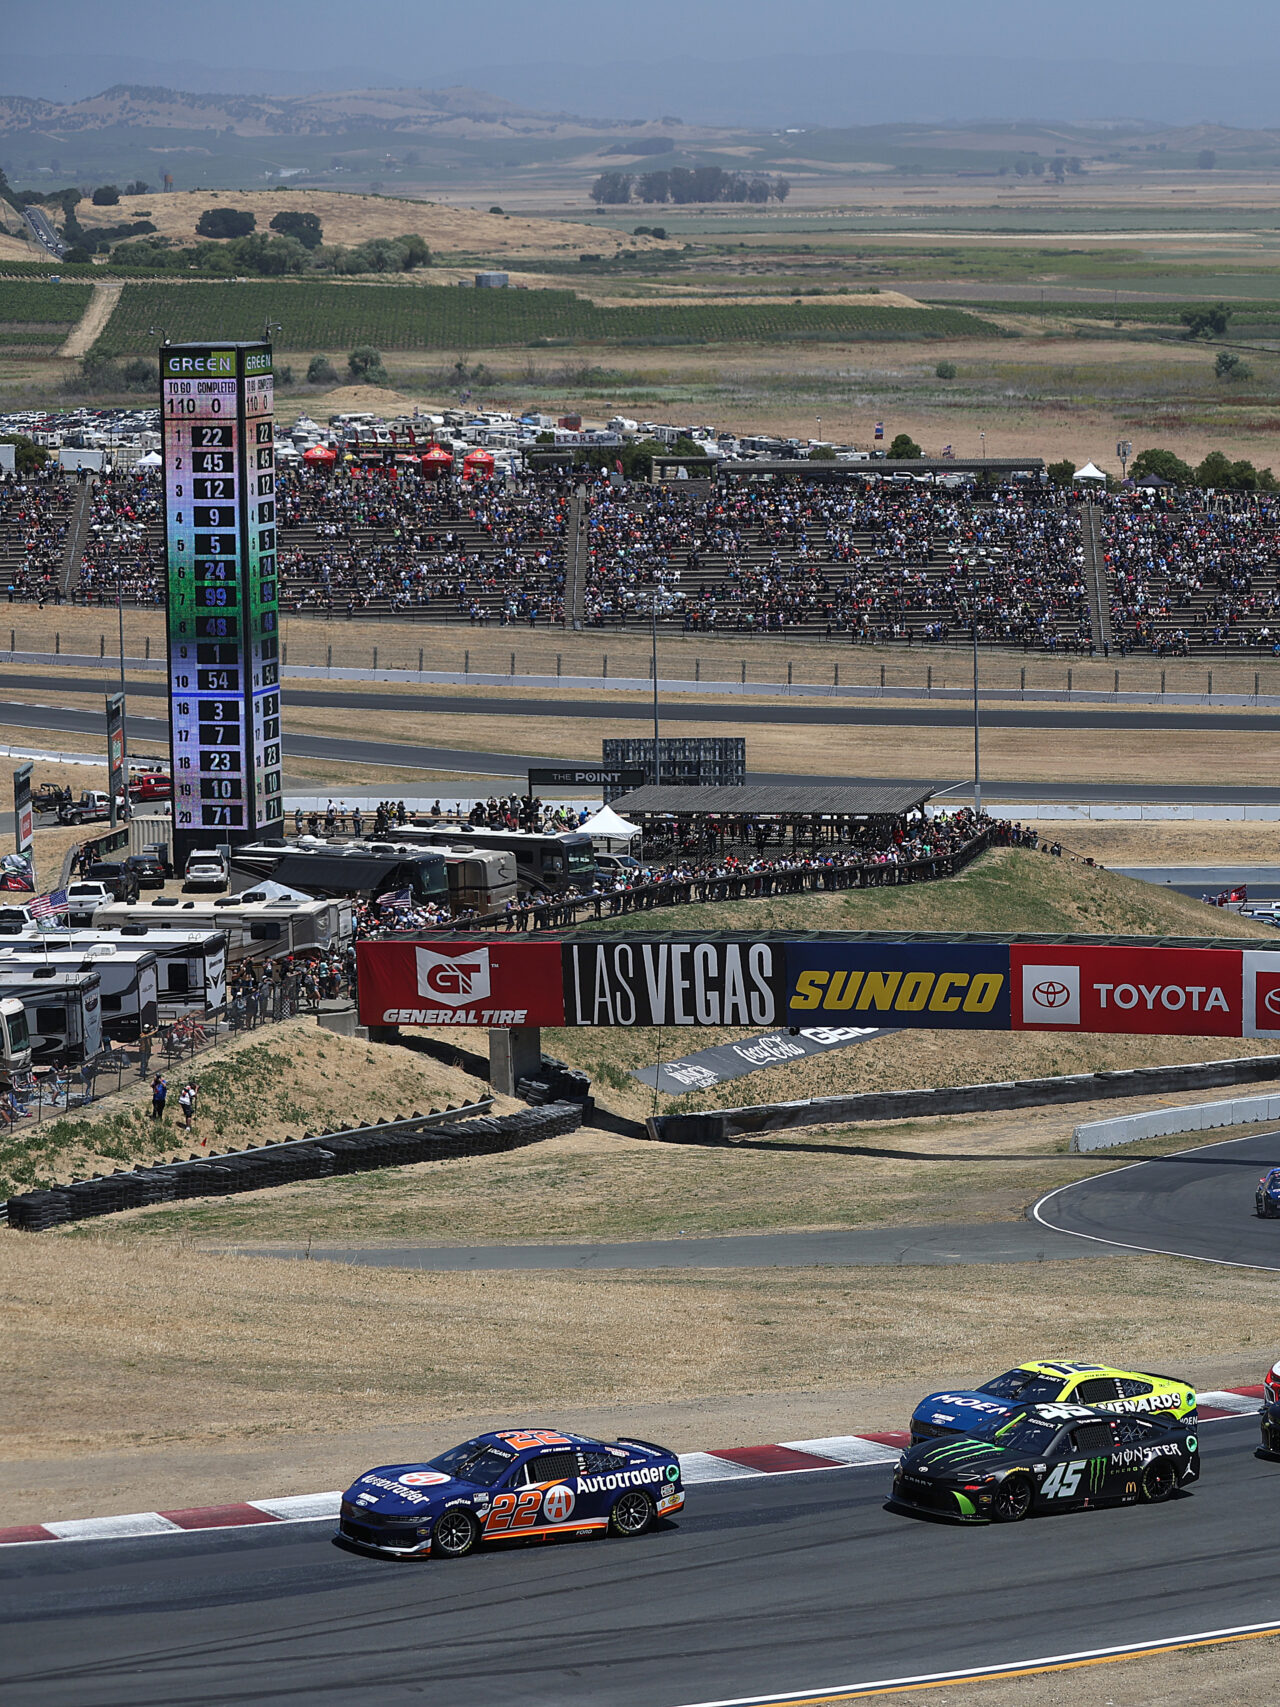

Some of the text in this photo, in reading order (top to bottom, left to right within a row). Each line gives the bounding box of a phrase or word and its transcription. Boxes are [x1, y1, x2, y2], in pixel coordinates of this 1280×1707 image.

[169, 357, 231, 372] GREEN
[246, 354, 271, 370] GREEN
[169, 381, 235, 394] TO GO COMPLETED
[167, 398, 221, 414] 110 0
[246, 396, 258, 411] 110
[176, 428, 223, 446] 1 22
[259, 425, 269, 442] 22
[175, 454, 223, 471] 2 45
[260, 451, 270, 468] 45
[176, 480, 224, 498] 3 12
[261, 476, 270, 493] 12
[176, 508, 219, 525] 4 9
[264, 504, 268, 521] 9
[177, 537, 220, 554] 5 5
[264, 531, 269, 548] 5
[178, 562, 226, 579] 6 24
[263, 557, 272, 575] 24
[180, 588, 226, 606] 7 99
[180, 618, 227, 636] 8 48
[180, 645, 220, 663] 9 1
[268, 641, 271, 658] 1
[175, 672, 228, 689] 10 54
[266, 667, 274, 683] 54
[177, 703, 223, 720] 16 3
[269, 697, 273, 714] 3
[177, 727, 224, 744] 17 7
[269, 722, 274, 737] 7
[178, 753, 230, 771] 18 23
[267, 747, 276, 765] 23
[269, 775, 277, 791] 10
[575, 772, 621, 782] POINT
[180, 784, 191, 796] 19
[212, 781, 231, 798] 10
[179, 807, 230, 824] 20 71
[270, 801, 277, 818] 71
[572, 943, 776, 1026] LAS VEGAS
[790, 970, 1004, 1013] SUNOCO
[1093, 983, 1230, 1012] TOYOTA
[382, 1008, 528, 1024] GENERAL TIRE
[669, 1064, 719, 1086] BUSCH
[695, 1077, 720, 1088] LIGHT
[1038, 1374, 1061, 1382] BLANEY
[931, 1394, 1008, 1415] MOEN
[1033, 1403, 1097, 1420] 45
[1098, 1393, 1181, 1413] MENARDS
[1028, 1418, 1056, 1428] REDDICK
[495, 1430, 573, 1451] 22
[487, 1449, 511, 1458] LOGANO
[1110, 1466, 1146, 1475] ENERGY
[576, 1466, 666, 1494] Autotrader
[904, 1475, 933, 1487] CAMRY
[1040, 1459, 1087, 1500] 45
[360, 1474, 430, 1504] Autotrader
[484, 1490, 542, 1532] 22
